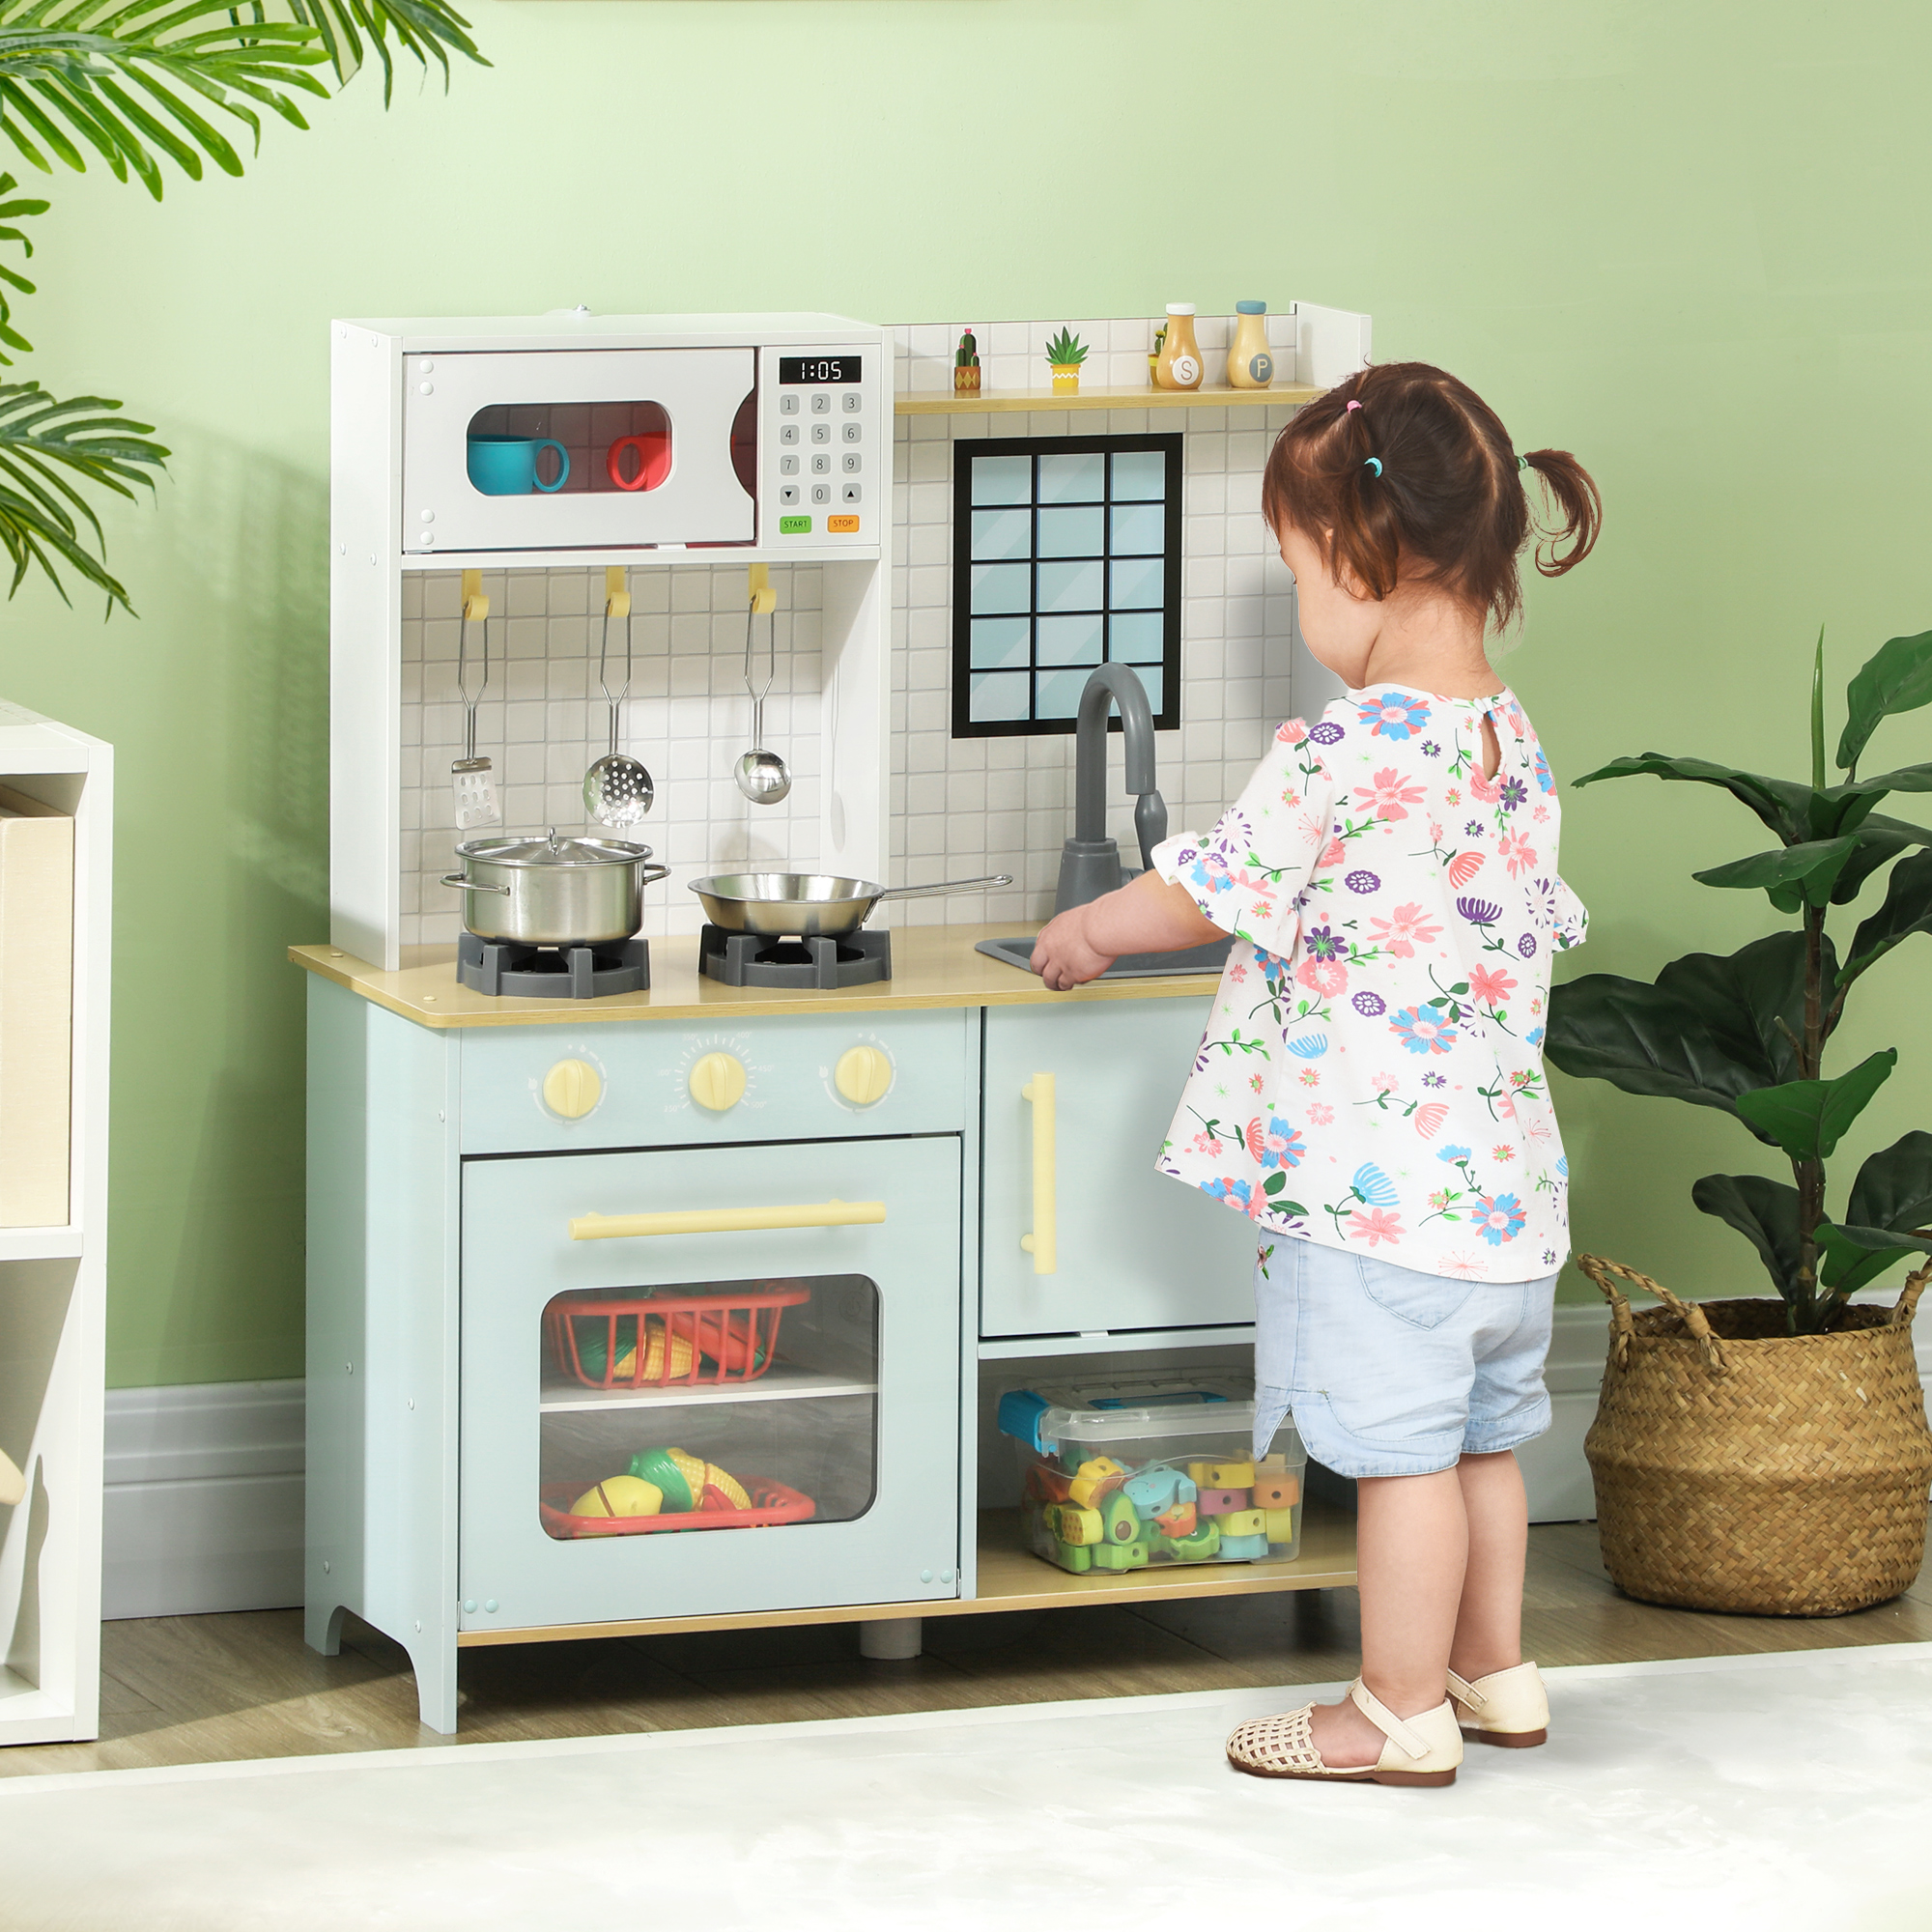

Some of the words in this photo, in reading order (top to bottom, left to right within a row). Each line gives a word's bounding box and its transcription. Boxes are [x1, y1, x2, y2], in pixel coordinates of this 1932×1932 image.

[801, 360, 841, 380] 1:05
[1180, 360, 1193, 380] S
[1257, 358, 1268, 378] P
[786, 399, 791, 410] 1
[817, 398, 823, 410] 2
[848, 397, 855, 409] 3
[785, 429, 792, 440] 4
[817, 428, 824, 440] 5
[847, 427, 855, 439] 6
[785, 459, 792, 469] 7
[816, 458, 823, 469] 8
[847, 457, 855, 469] 9
[816, 489, 823, 499] 0
[784, 520, 808, 528] START
[833, 519, 854, 527] STOP
